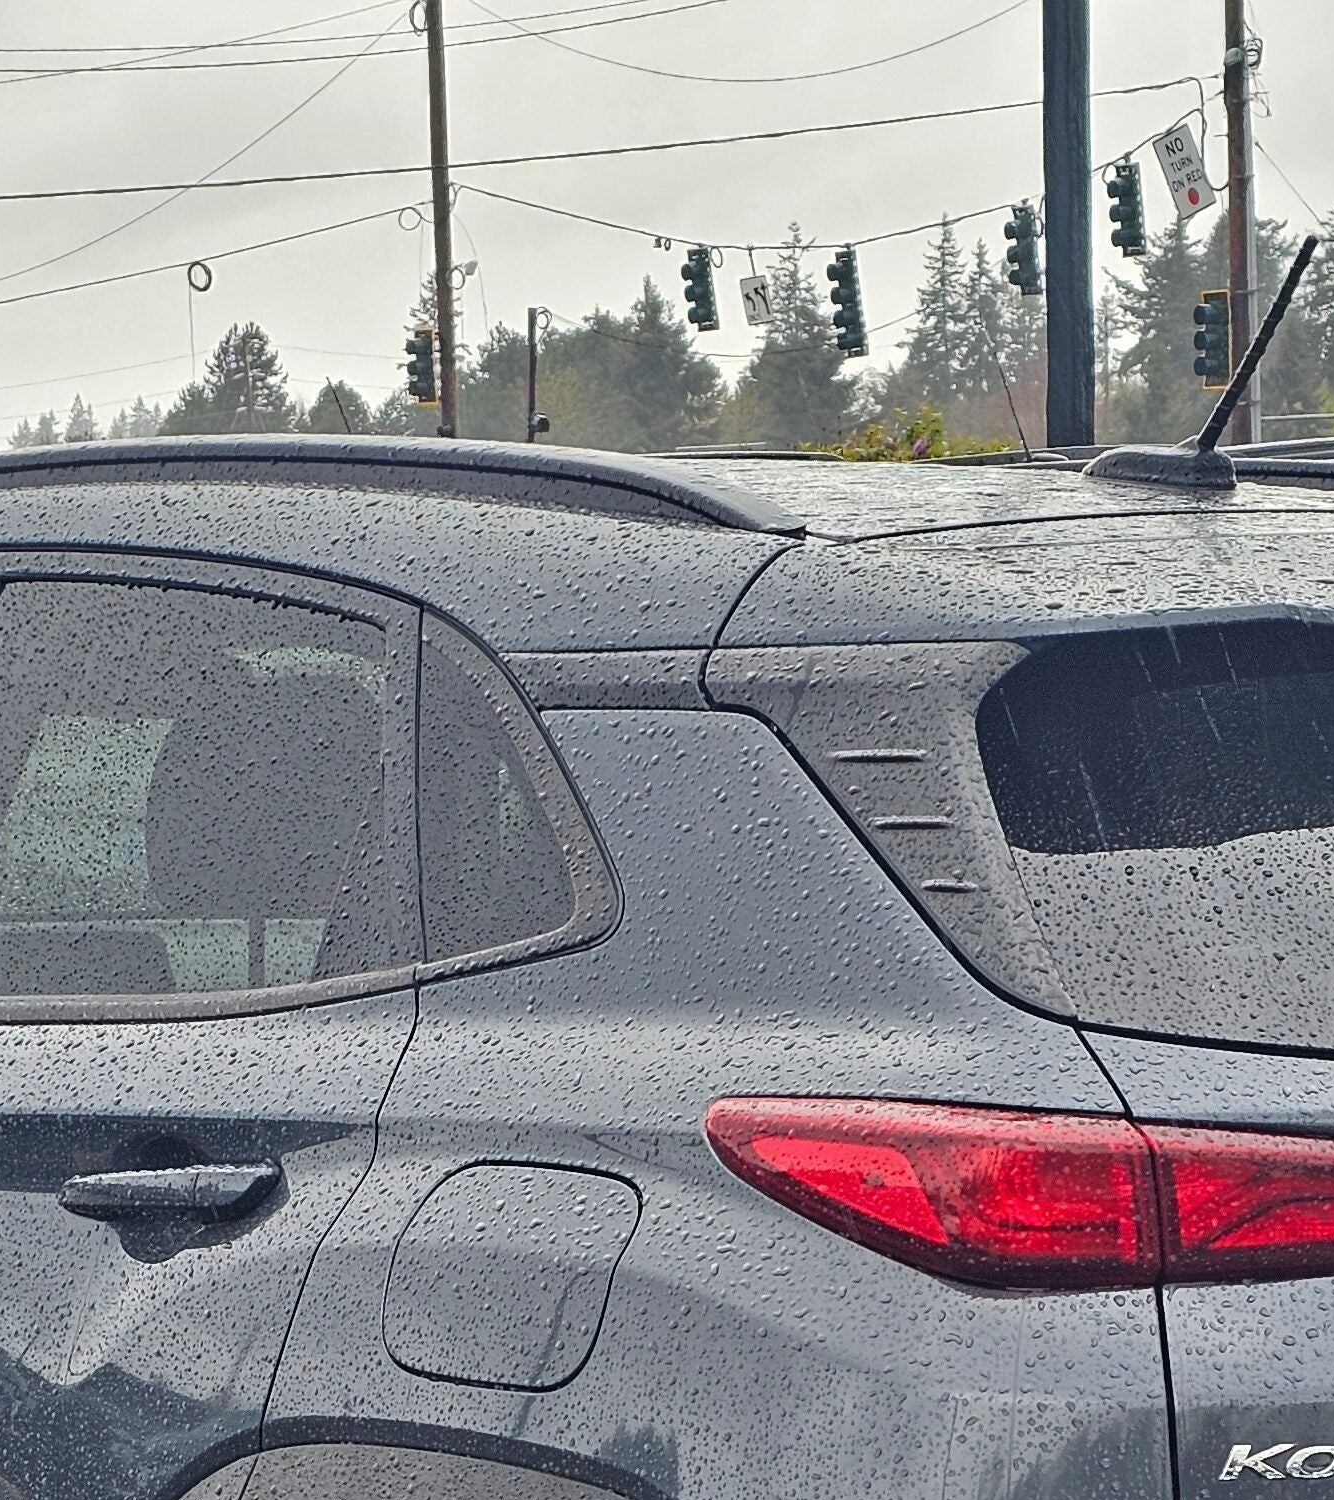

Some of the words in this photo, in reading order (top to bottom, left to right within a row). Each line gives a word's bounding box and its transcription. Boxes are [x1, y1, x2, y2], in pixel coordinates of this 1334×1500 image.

[1164, 137, 1184, 157] NO
[1169, 155, 1193, 173] TURN
[1172, 180, 1185, 192] ON
[1185, 168, 1203, 184] RED
